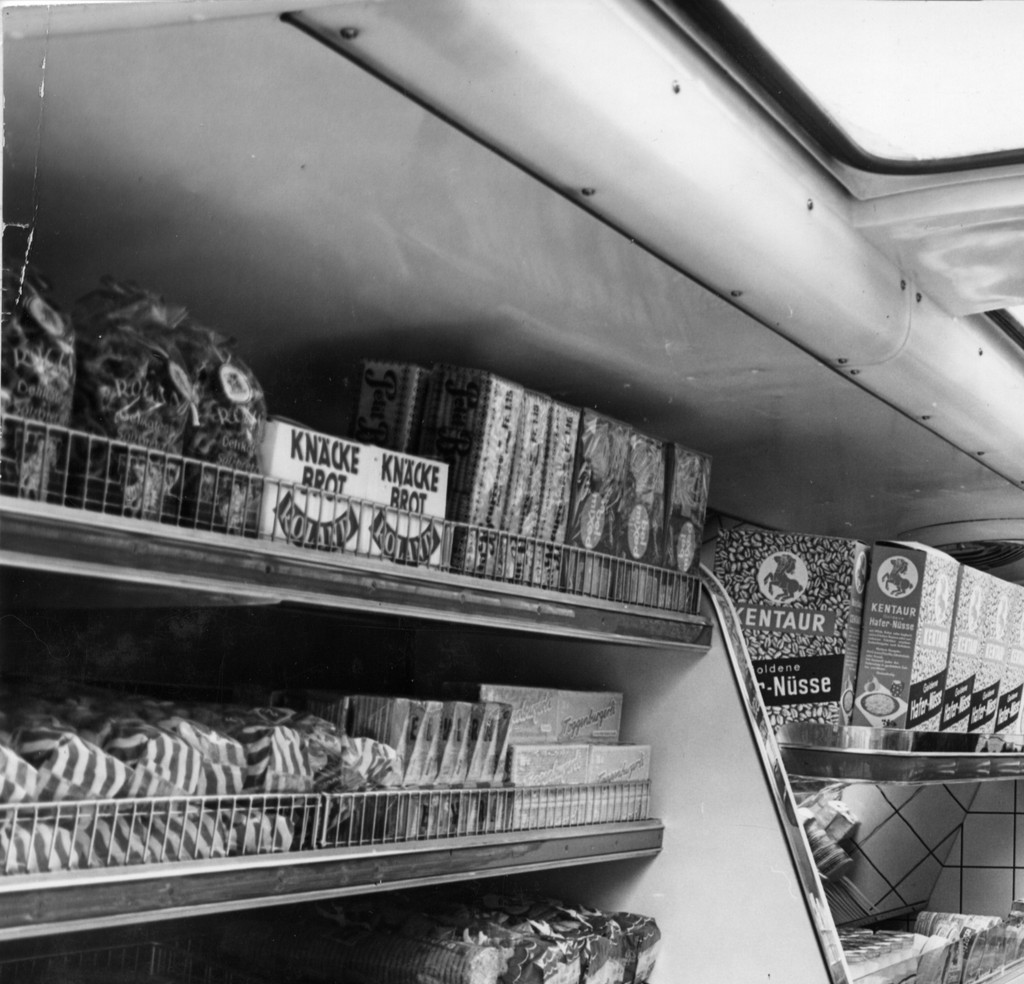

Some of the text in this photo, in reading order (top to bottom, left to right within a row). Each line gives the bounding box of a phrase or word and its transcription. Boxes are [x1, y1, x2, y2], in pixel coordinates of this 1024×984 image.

[290, 428, 361, 475] KNÄCKE
[302, 465, 348, 503] BROT
[381, 452, 441, 493] KNÄCKE
[390, 486, 428, 517] BROT
[869, 617, 915, 631] Hafer-Nüsse
[871, 602, 917, 618] KENTAUR
